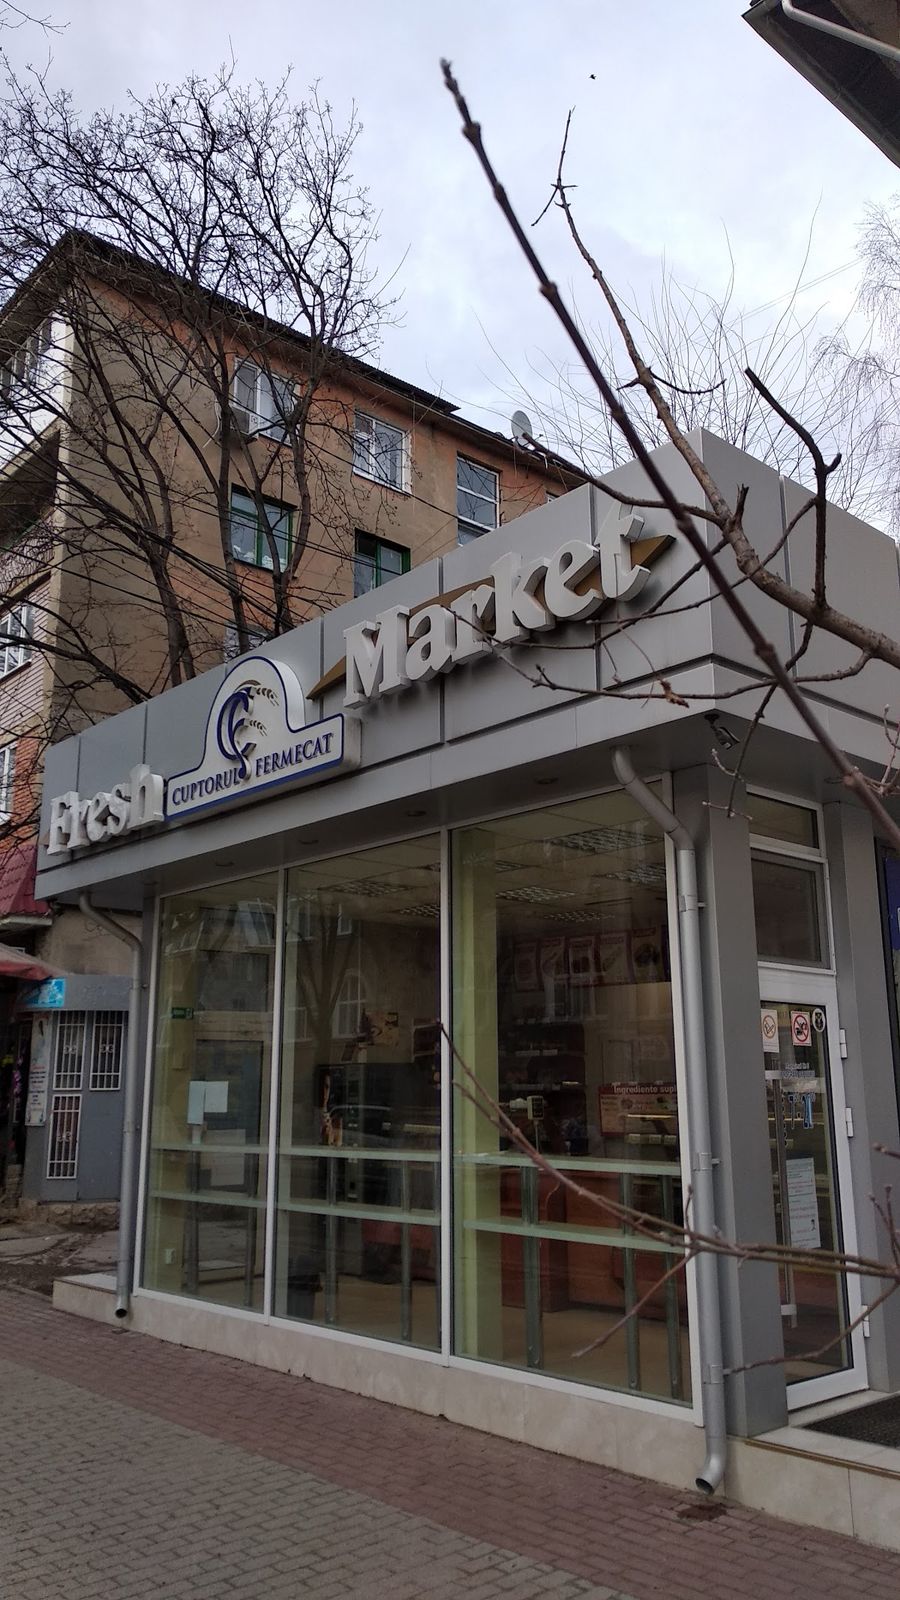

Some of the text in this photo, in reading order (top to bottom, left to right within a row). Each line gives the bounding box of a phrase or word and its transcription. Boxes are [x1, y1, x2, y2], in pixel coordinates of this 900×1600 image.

[46, 502, 652, 855] Fresh Market
[172, 732, 334, 806] CUPTORUL FERMECAT
[612, 1083, 657, 1095] Ingrediente
